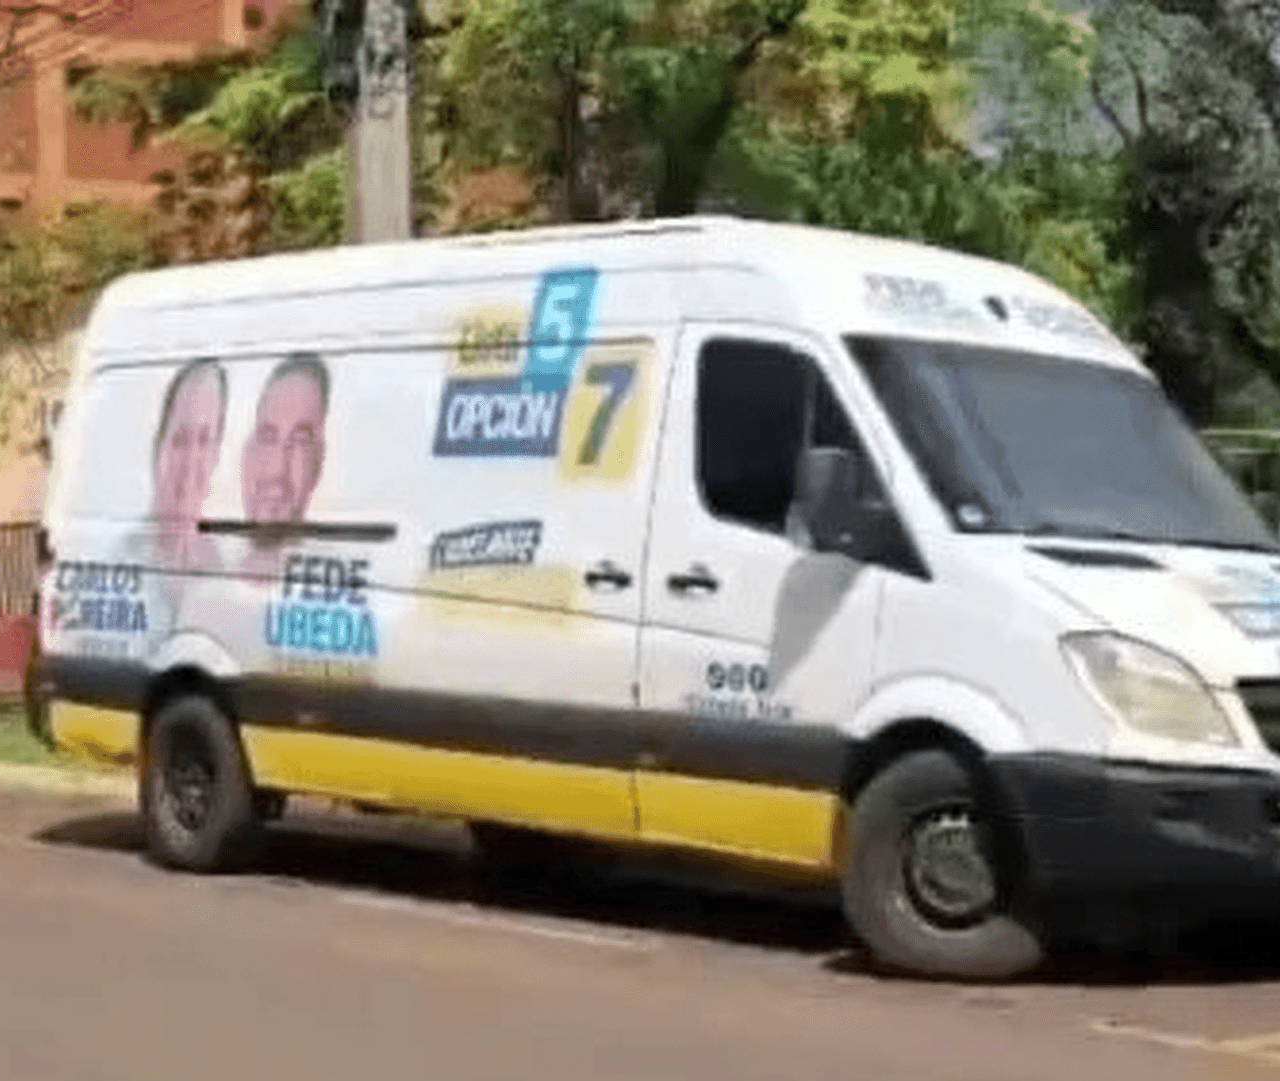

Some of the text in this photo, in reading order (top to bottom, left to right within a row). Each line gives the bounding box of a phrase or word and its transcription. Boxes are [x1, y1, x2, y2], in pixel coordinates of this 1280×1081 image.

[538, 283, 581, 361] 5
[577, 362, 638, 466] 7
[284, 555, 370, 604] FEDE
